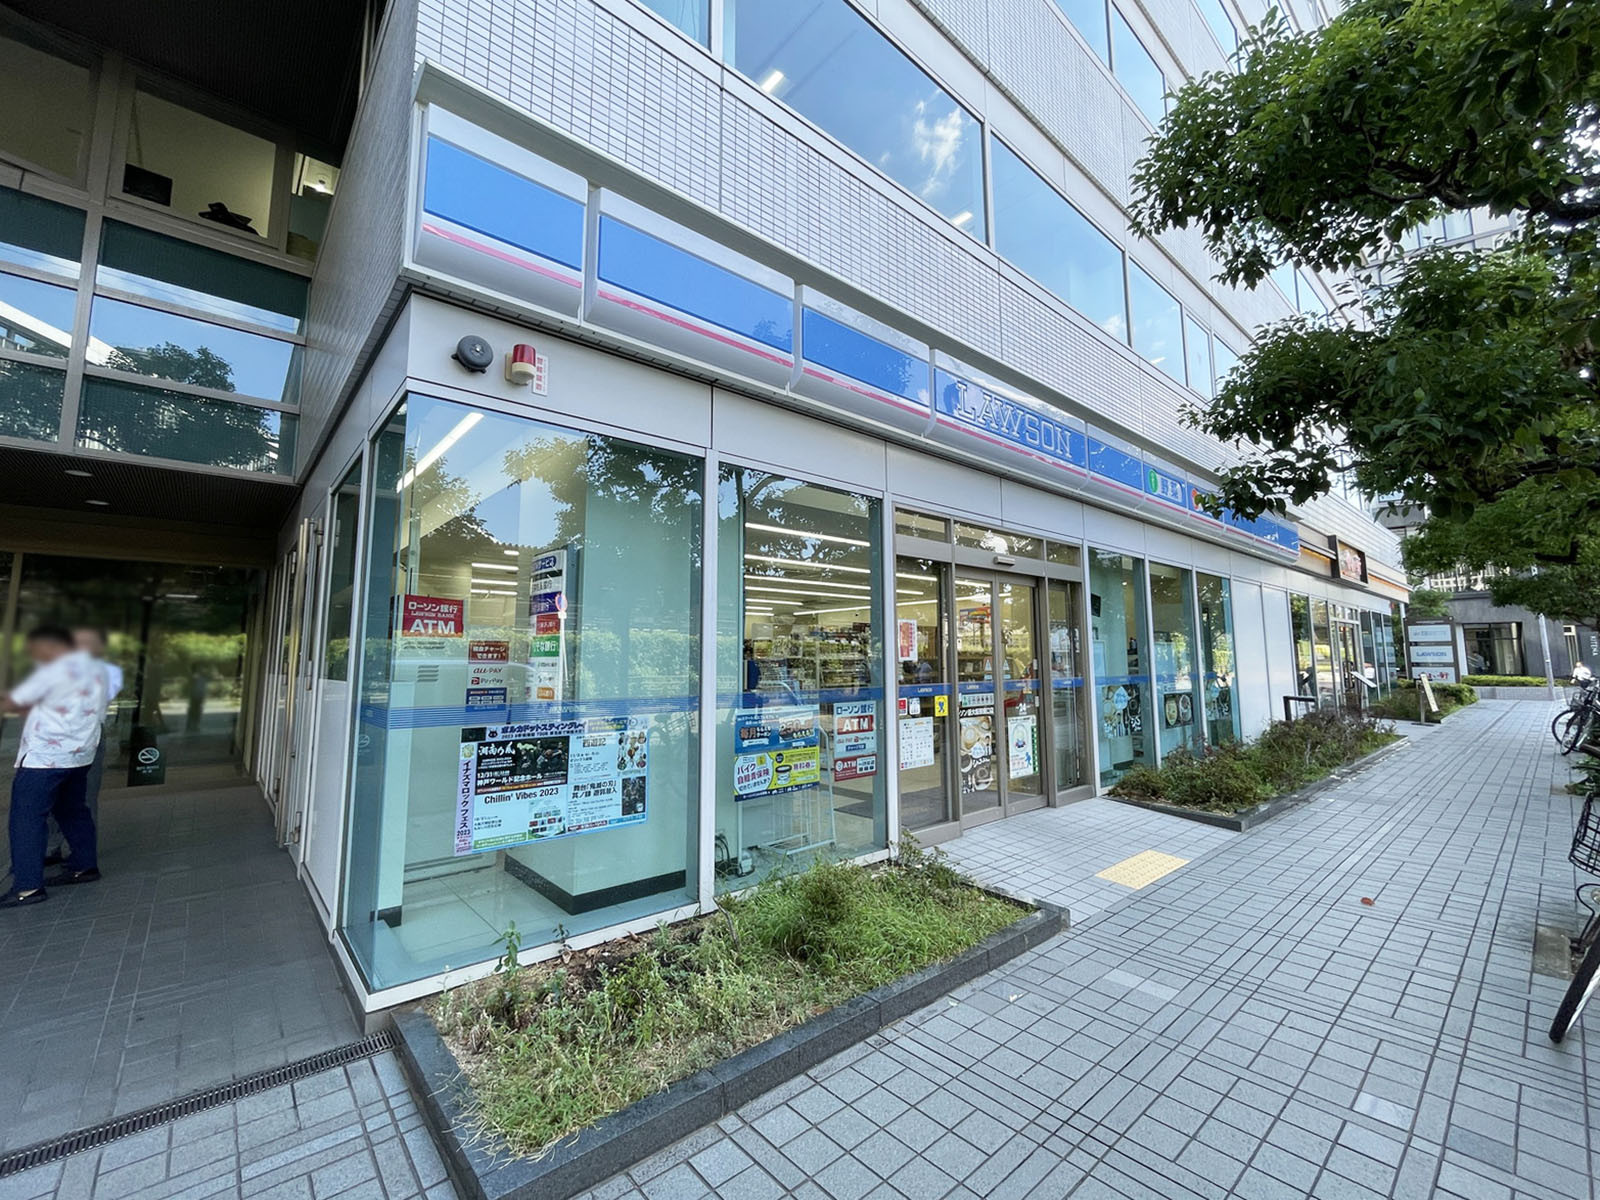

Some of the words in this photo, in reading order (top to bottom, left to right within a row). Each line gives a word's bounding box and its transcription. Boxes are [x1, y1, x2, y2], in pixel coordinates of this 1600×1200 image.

[955, 381, 1072, 459] LAWSON
[408, 601, 458, 614] ローソン銀行
[410, 618, 455, 635] ATM
[836, 703, 874, 715] ローソン銀行
[842, 717, 869, 732] ATM
[737, 763, 756, 775] バイク
[484, 793, 514, 805] Chillin'
[515, 791, 537, 801] Vibes
[539, 787, 559, 797] 2023
